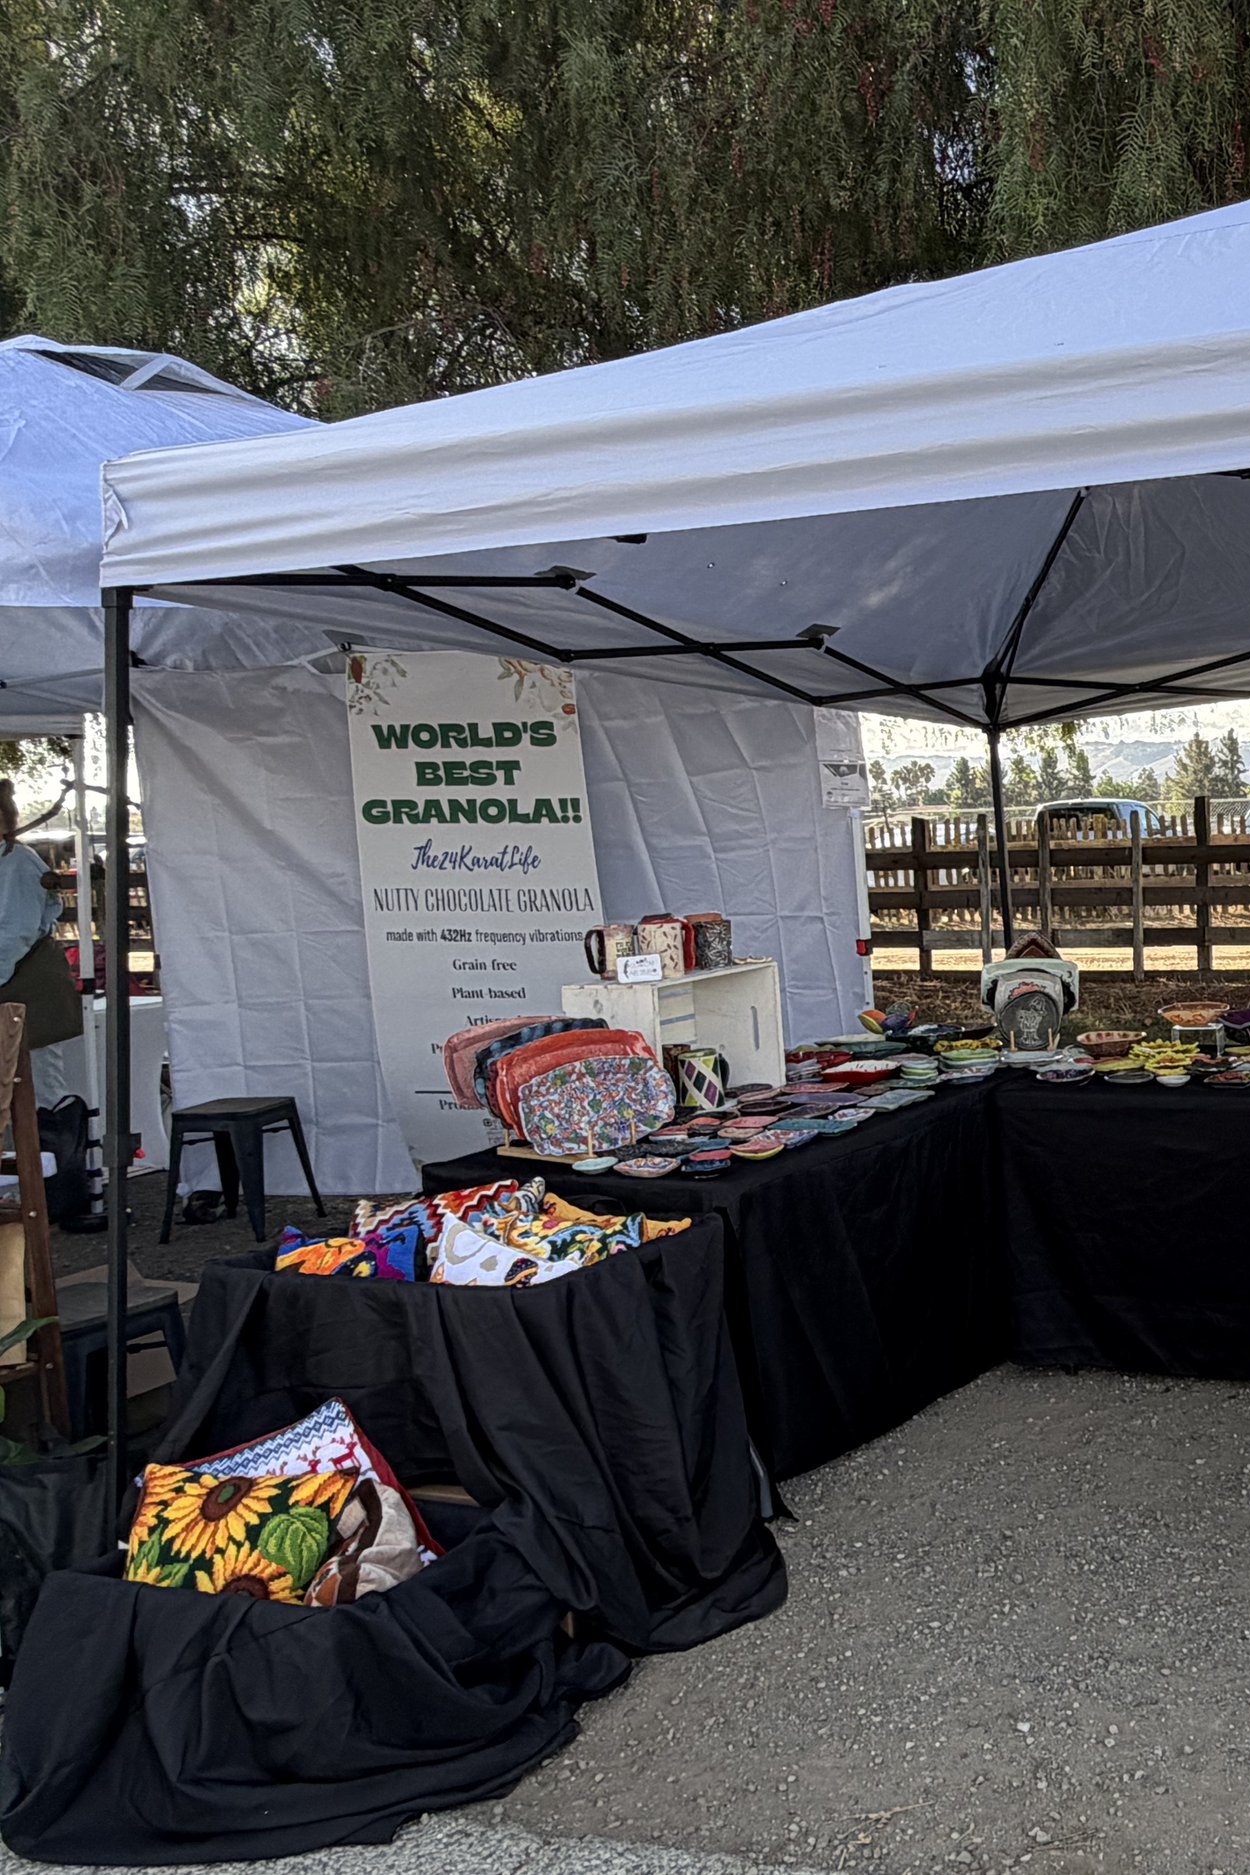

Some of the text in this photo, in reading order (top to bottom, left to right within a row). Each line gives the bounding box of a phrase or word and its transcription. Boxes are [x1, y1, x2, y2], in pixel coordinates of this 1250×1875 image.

[371, 720, 557, 749] WORLD'S
[414, 760, 521, 786] BEST
[361, 798, 582, 824] GRANOLA!!
[373, 887, 595, 912] NUTTY CHOCOLATE GRANOLA
[386, 928, 413, 942] made
[416, 928, 437, 942] with
[440, 929, 472, 942] 432Hz
[475, 929, 526, 945] frequency
[452, 959, 517, 971] Grain free
